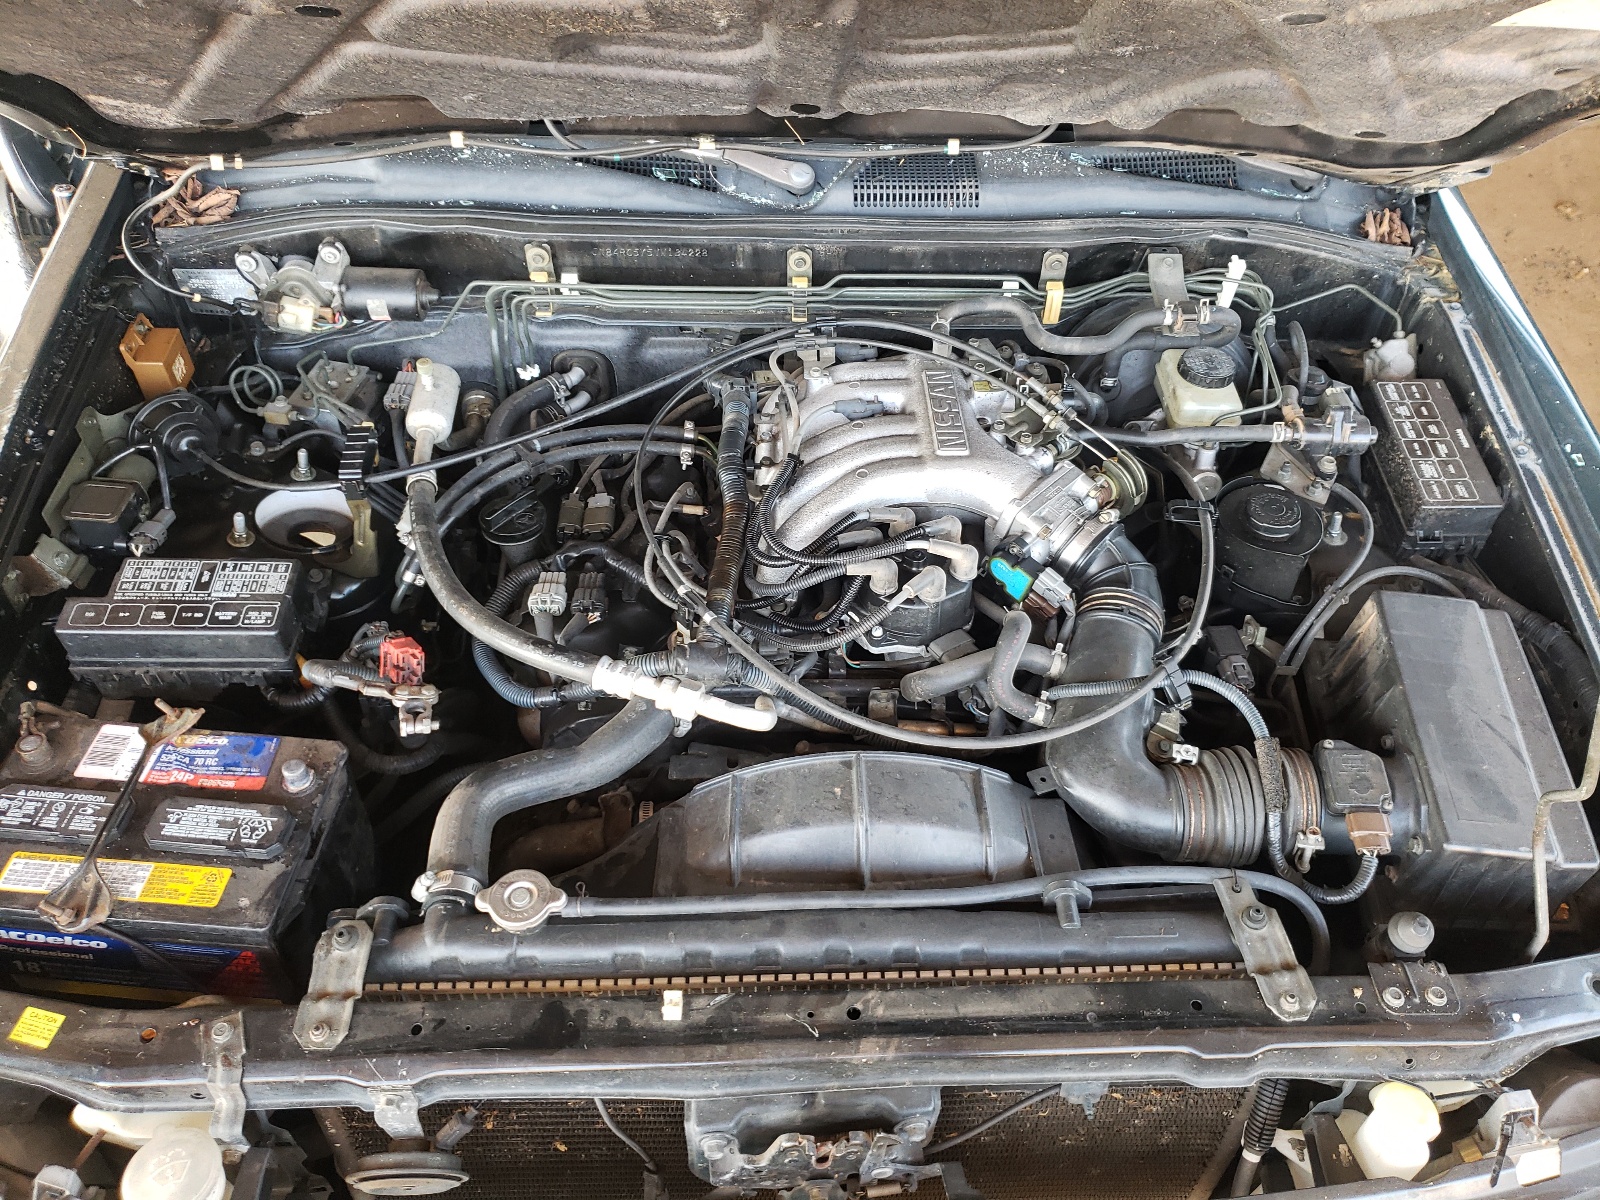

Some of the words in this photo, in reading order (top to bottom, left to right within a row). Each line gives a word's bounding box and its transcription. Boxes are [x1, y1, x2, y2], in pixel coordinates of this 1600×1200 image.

[925, 371, 967, 450] NISSAN
[193, 757, 204, 766] 70
[204, 758, 219, 766] RC
[169, 770, 194, 782] 24P
[26, 789, 65, 800] DANGER
[71, 793, 107, 803] POISON
[0, 929, 108, 949] ACDelco
[0, 943, 94, 960] Professional
